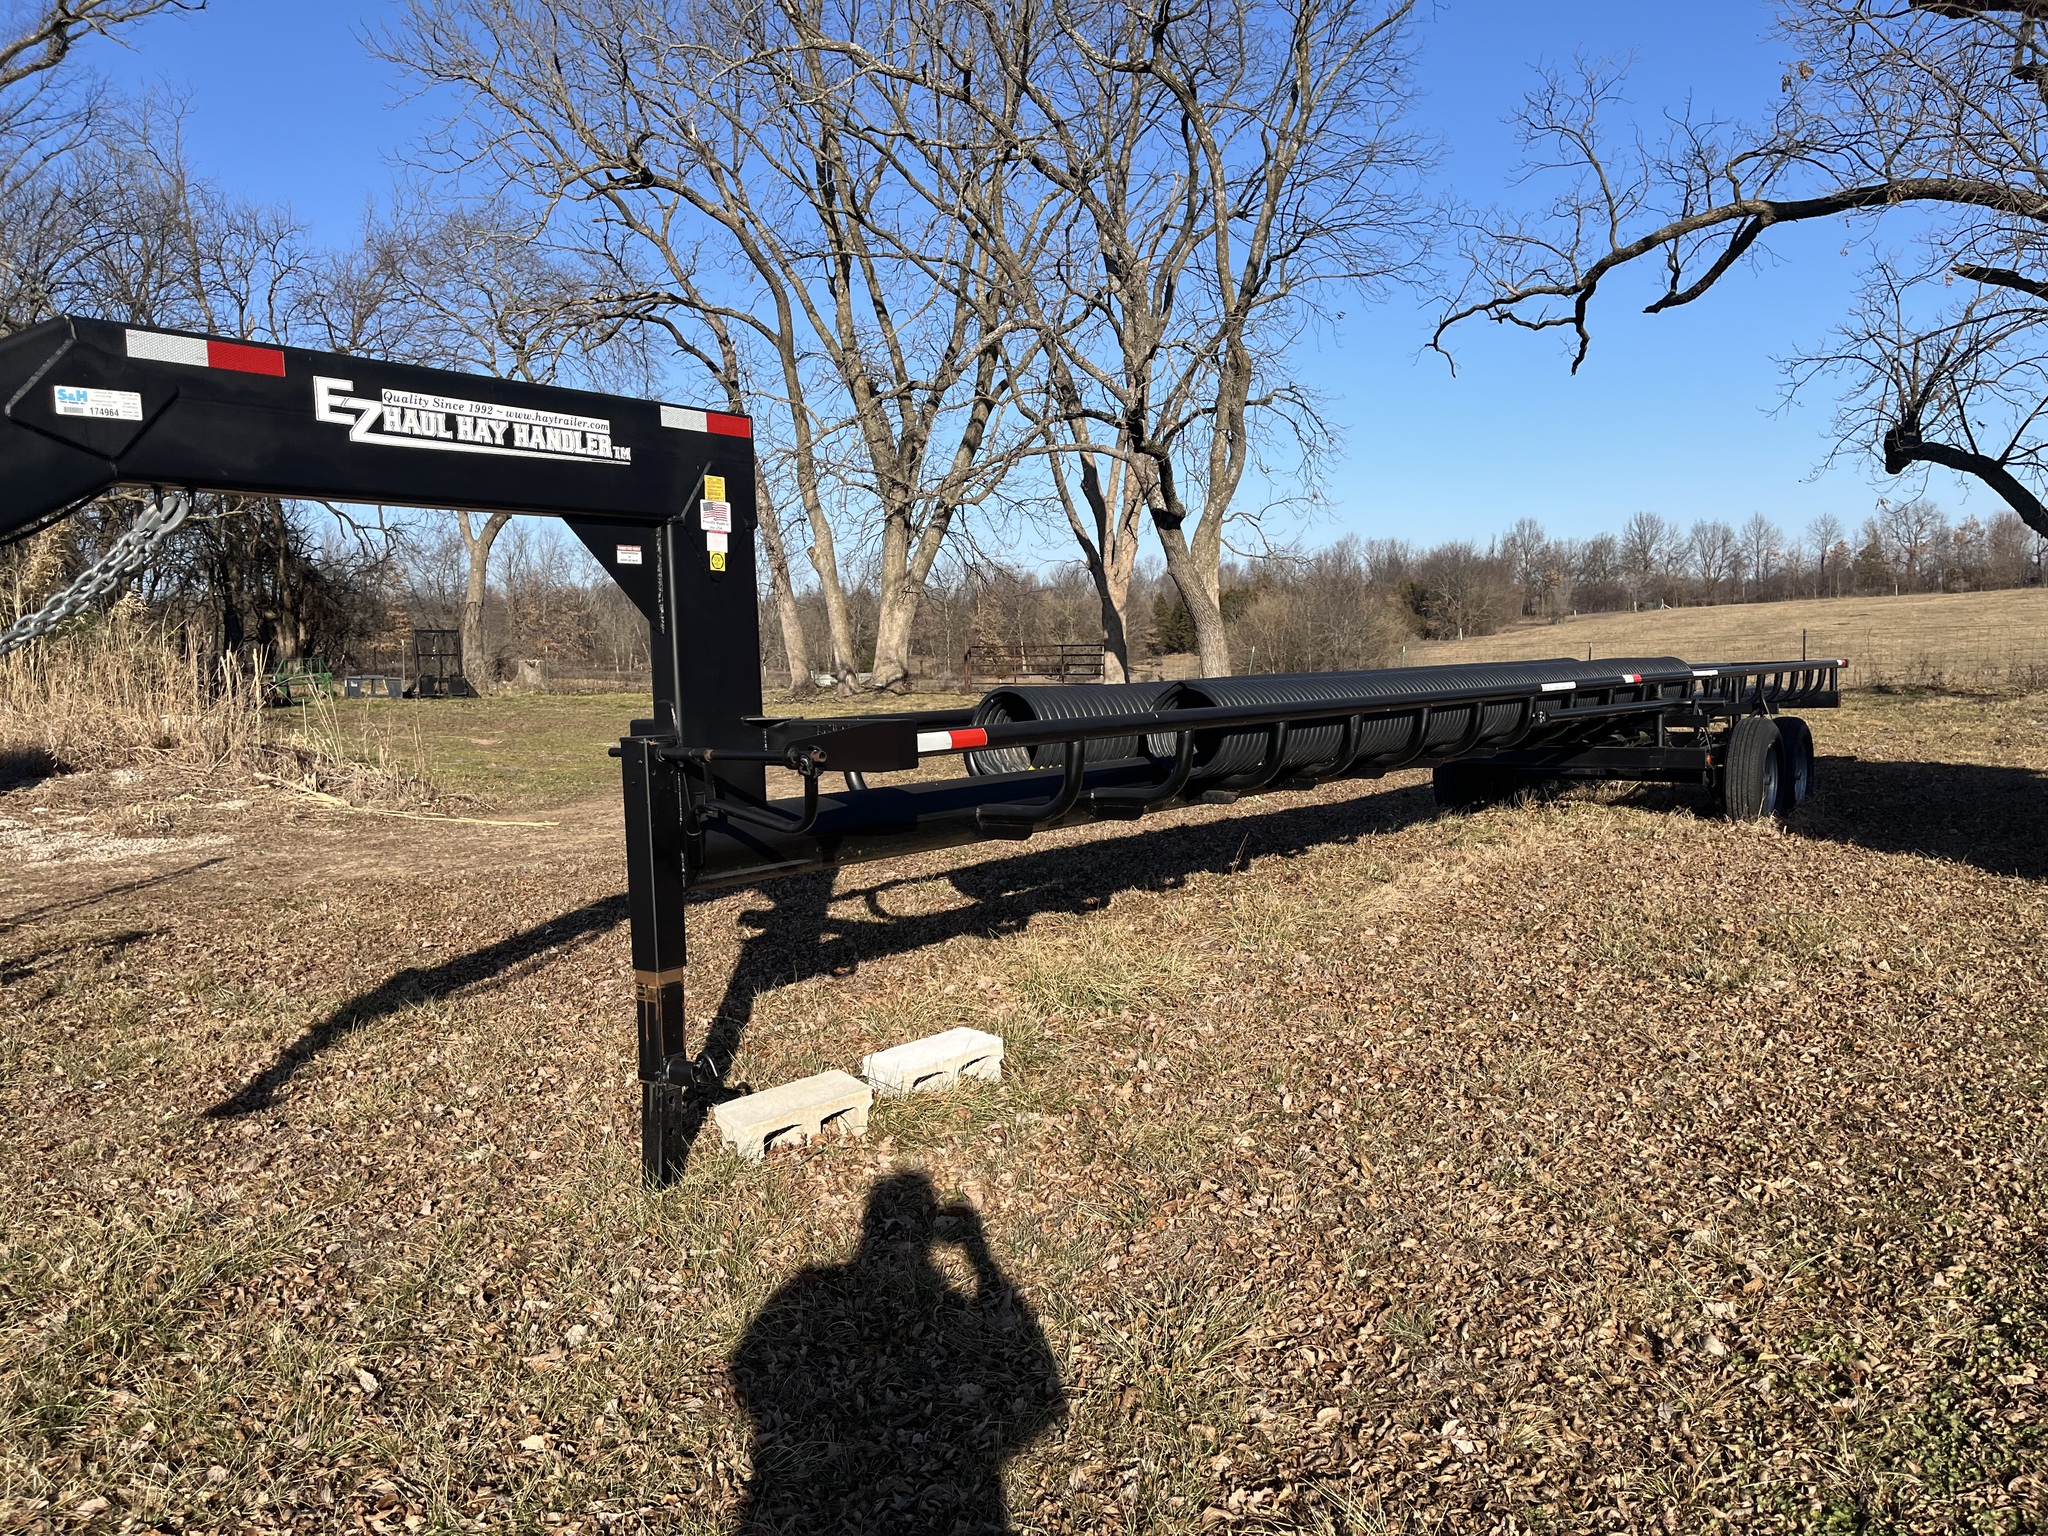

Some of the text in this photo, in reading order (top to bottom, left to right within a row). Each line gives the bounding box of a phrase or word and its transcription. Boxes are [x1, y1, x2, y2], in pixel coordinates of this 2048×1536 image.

[57, 388, 88, 402] S&H
[90, 407, 119, 417] 174964
[313, 375, 631, 461] EZ HAUL HAY HANDLER TM
[383, 391, 429, 408] Quality
[432, 397, 465, 411] Since
[469, 403, 493, 415] 1992
[505, 411, 609, 431] www.haytrailer.com
